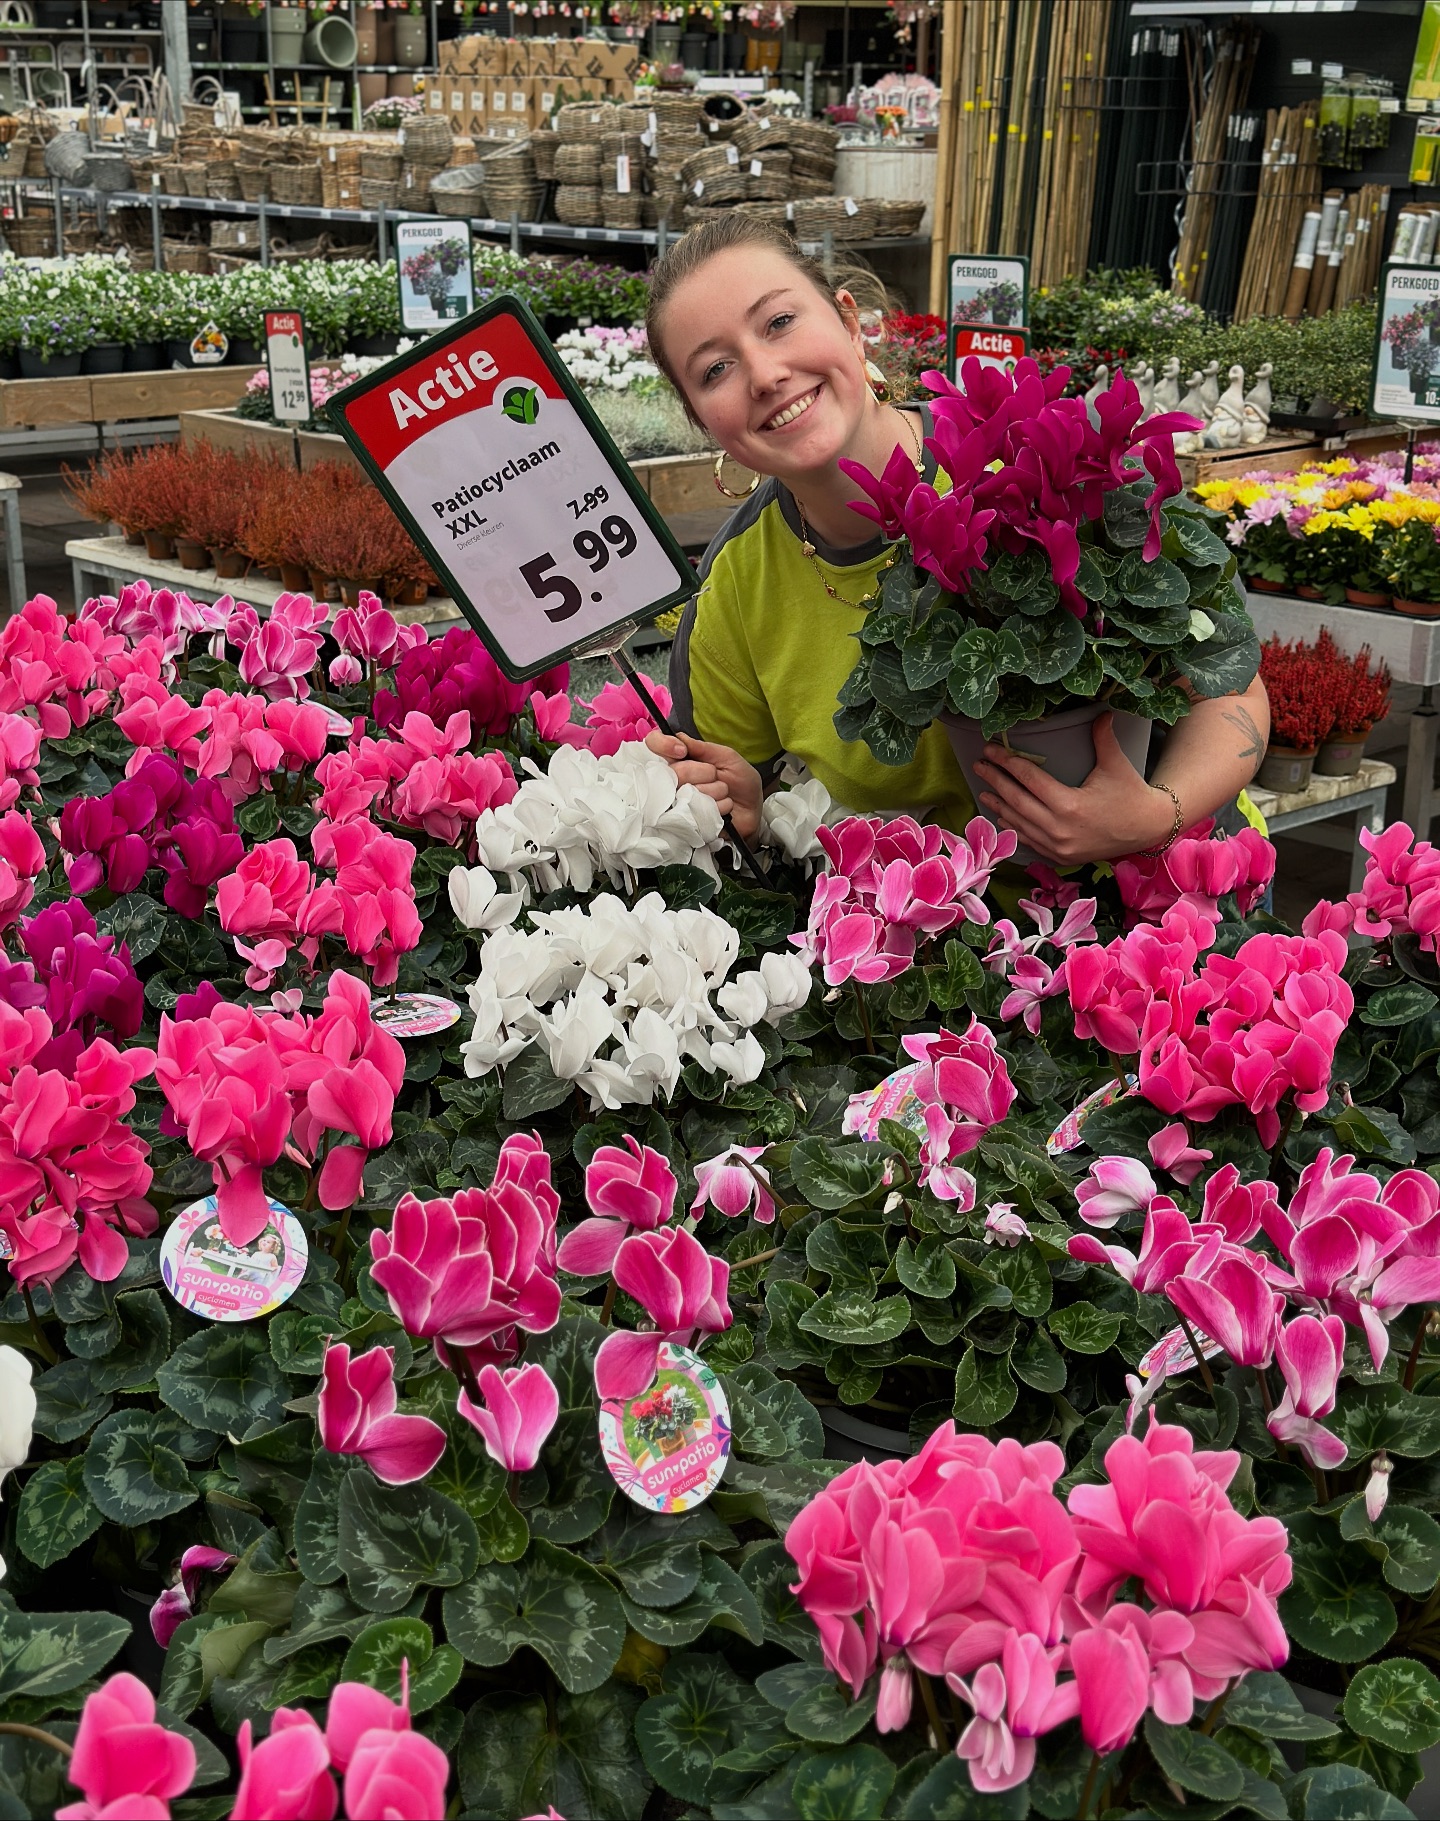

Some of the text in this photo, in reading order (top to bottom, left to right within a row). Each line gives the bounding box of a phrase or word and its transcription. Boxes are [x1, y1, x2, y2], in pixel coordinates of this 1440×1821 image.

[402, 228, 443, 238] PERKGOED
[956, 267, 998, 279] PERKGOED
[1391, 276, 1439, 290] PERKGOED
[273, 316, 296, 330] Actie
[970, 332, 1013, 353] Actie
[388, 350, 499, 430] Actie
[431, 439, 562, 519] Patiocyclaam
[566, 484, 611, 520] 7.99
[445, 509, 488, 540] XXL
[457, 521, 505, 551] Diverse kleuren
[198, 1294, 236, 1309] cyclamen
[672, 1472, 704, 1495] cyclamen
